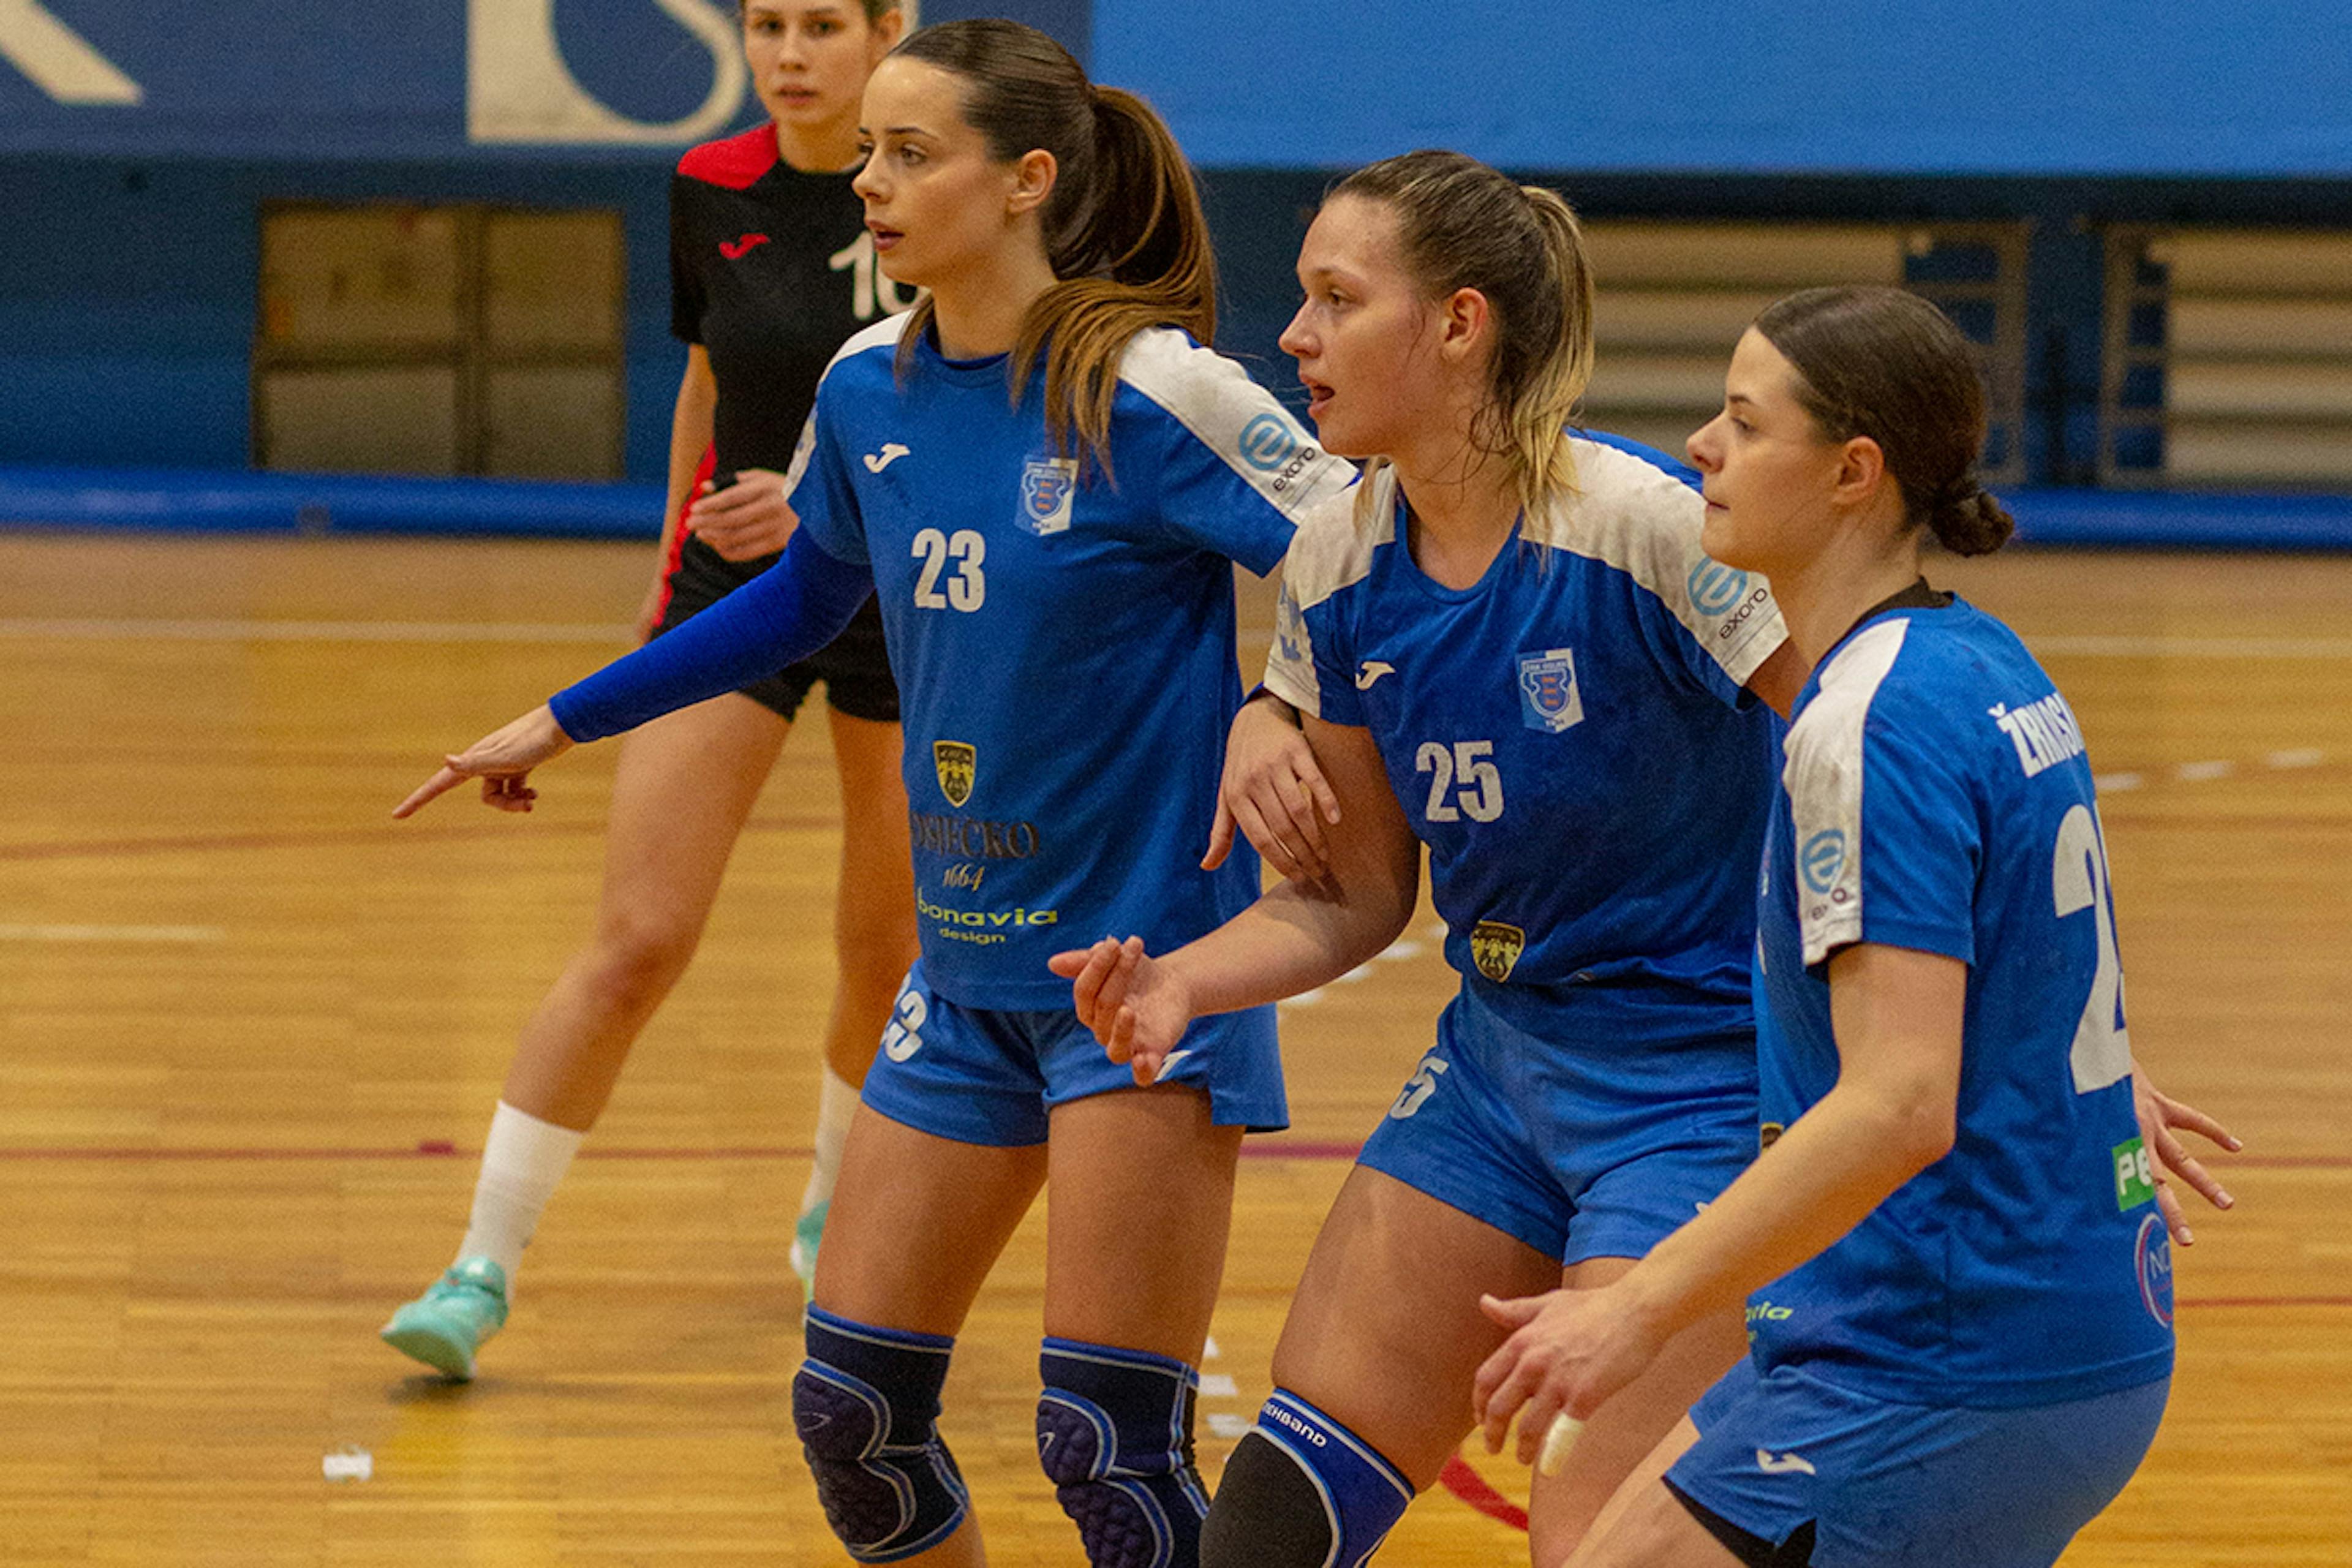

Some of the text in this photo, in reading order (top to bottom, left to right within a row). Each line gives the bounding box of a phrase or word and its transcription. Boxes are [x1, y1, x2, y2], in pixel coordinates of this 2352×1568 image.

[1273, 447, 1316, 491] exoro
[911, 527, 986, 612] 23
[1719, 588, 1768, 639] exoro
[1415, 740, 1504, 823] 25
[943, 862, 986, 892] 1664
[917, 886, 1058, 927] bonavia
[939, 927, 1006, 945] design
[2052, 803, 2133, 1095] 2
[881, 971, 927, 1063] 3
